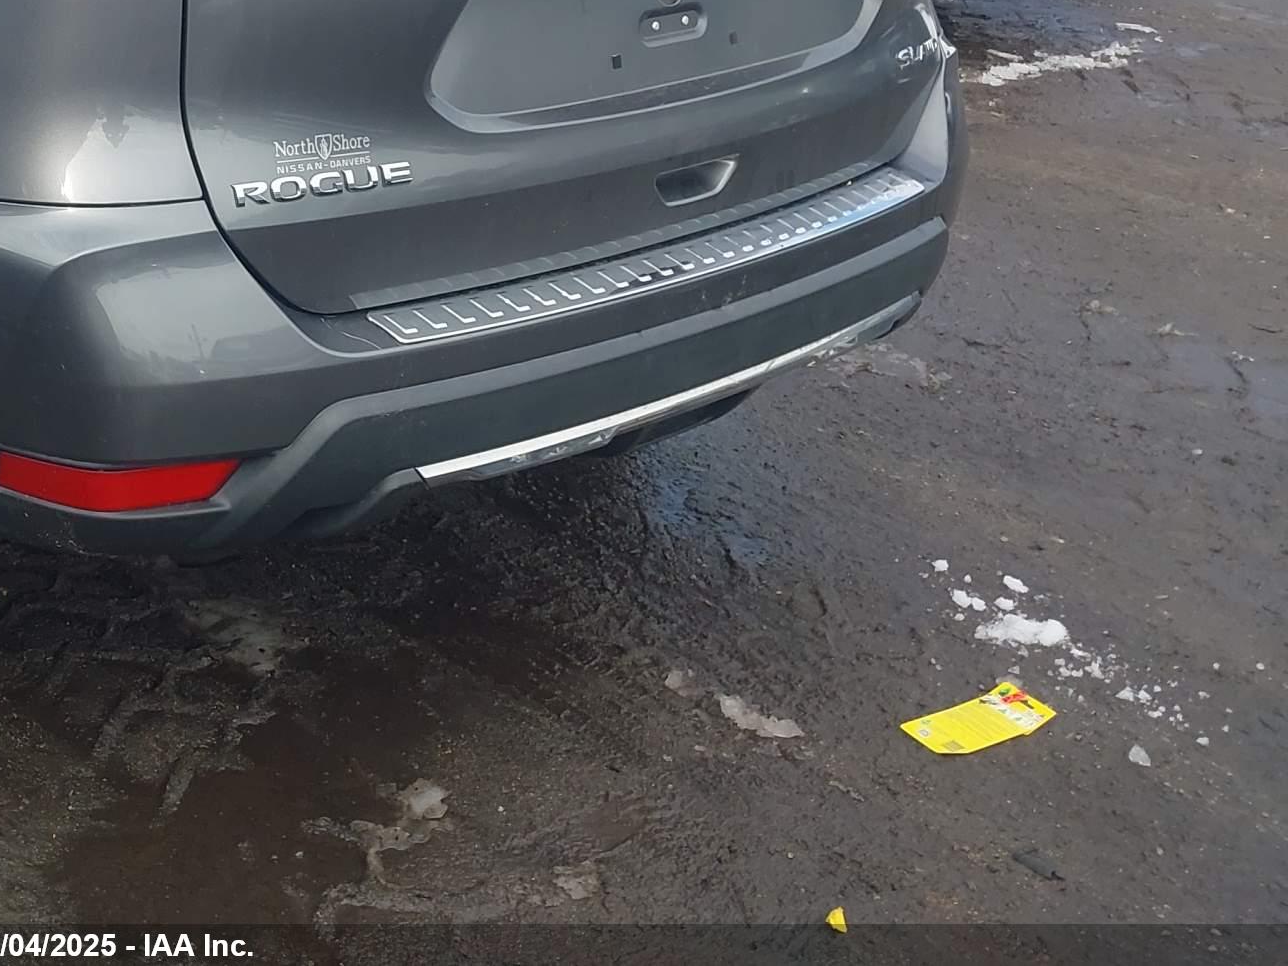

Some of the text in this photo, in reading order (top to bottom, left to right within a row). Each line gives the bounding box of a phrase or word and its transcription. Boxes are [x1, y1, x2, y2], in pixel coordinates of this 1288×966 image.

[273, 134, 371, 158] North Shore
[231, 161, 414, 208] ROGUE
